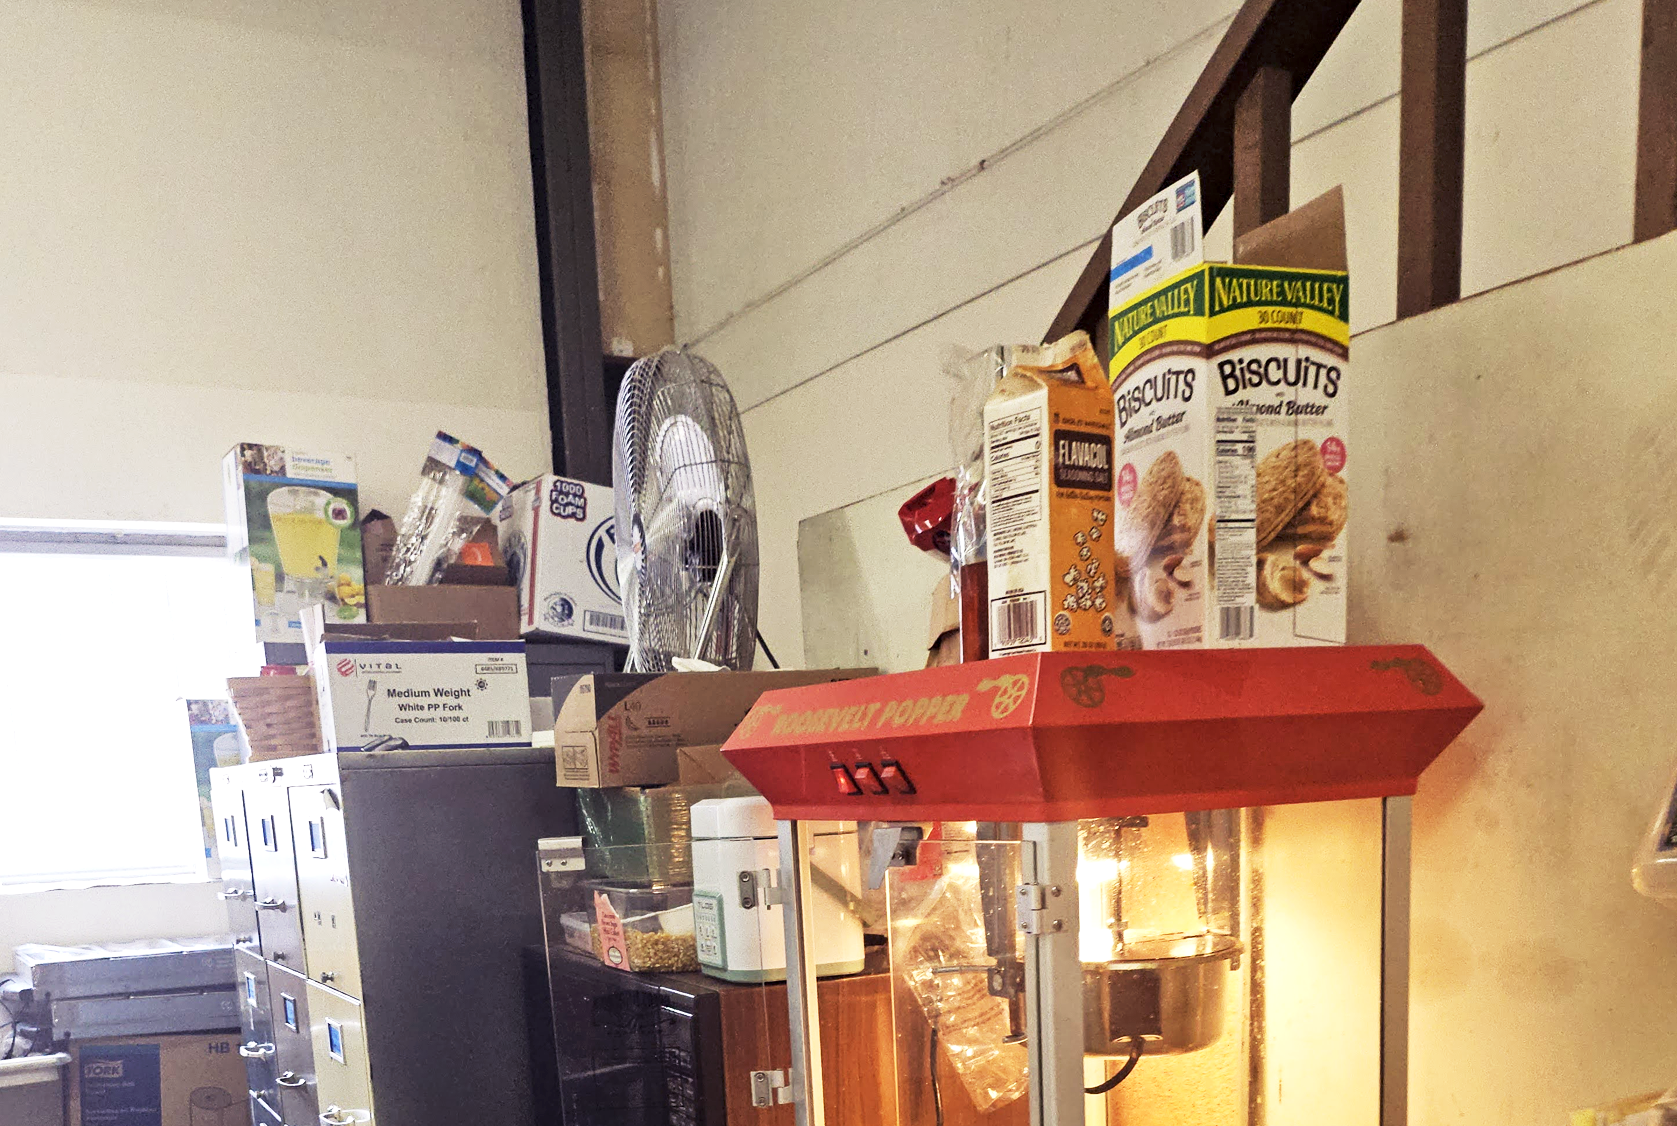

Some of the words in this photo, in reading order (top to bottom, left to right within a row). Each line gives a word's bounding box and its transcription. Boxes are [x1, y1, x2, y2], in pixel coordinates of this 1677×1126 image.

[1215, 276, 1282, 312] NATURE
[1284, 279, 1344, 319] VALLEY
[1114, 301, 1154, 354] NATURE
[1154, 279, 1198, 319] VALLEY
[1285, 400, 1329, 416] Butter
[1059, 440, 1109, 470] FLAVACOL
[555, 481, 583, 494] 1000
[552, 492, 585, 508] FOAM
[552, 503, 584, 519] CUPS
[387, 688, 431, 698] Medium
[434, 687, 472, 700] Weight
[398, 703, 425, 712] White
[427, 703, 440, 711] PP
[442, 702, 464, 712] Fork
[876, 693, 970, 729] POPPER
[413, 716, 437, 724] Count:
